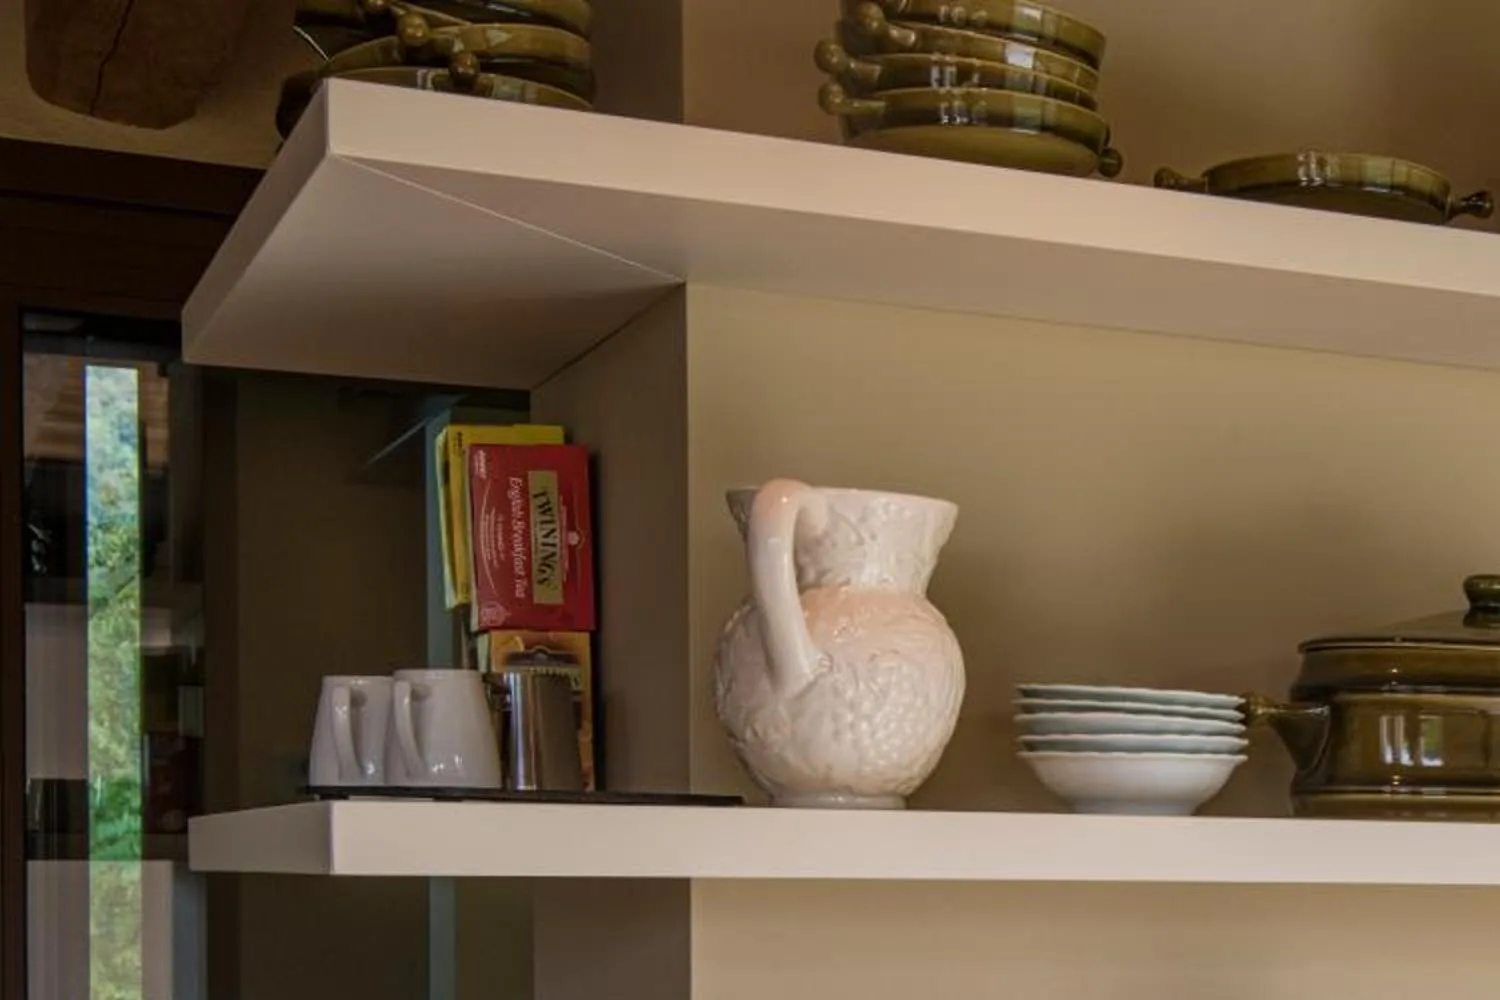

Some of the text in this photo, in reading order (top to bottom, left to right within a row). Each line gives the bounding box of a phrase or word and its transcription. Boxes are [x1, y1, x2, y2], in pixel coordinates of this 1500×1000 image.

[507, 477, 529, 598] English Breakfast Tea
[532, 490, 559, 587] TWININGS
